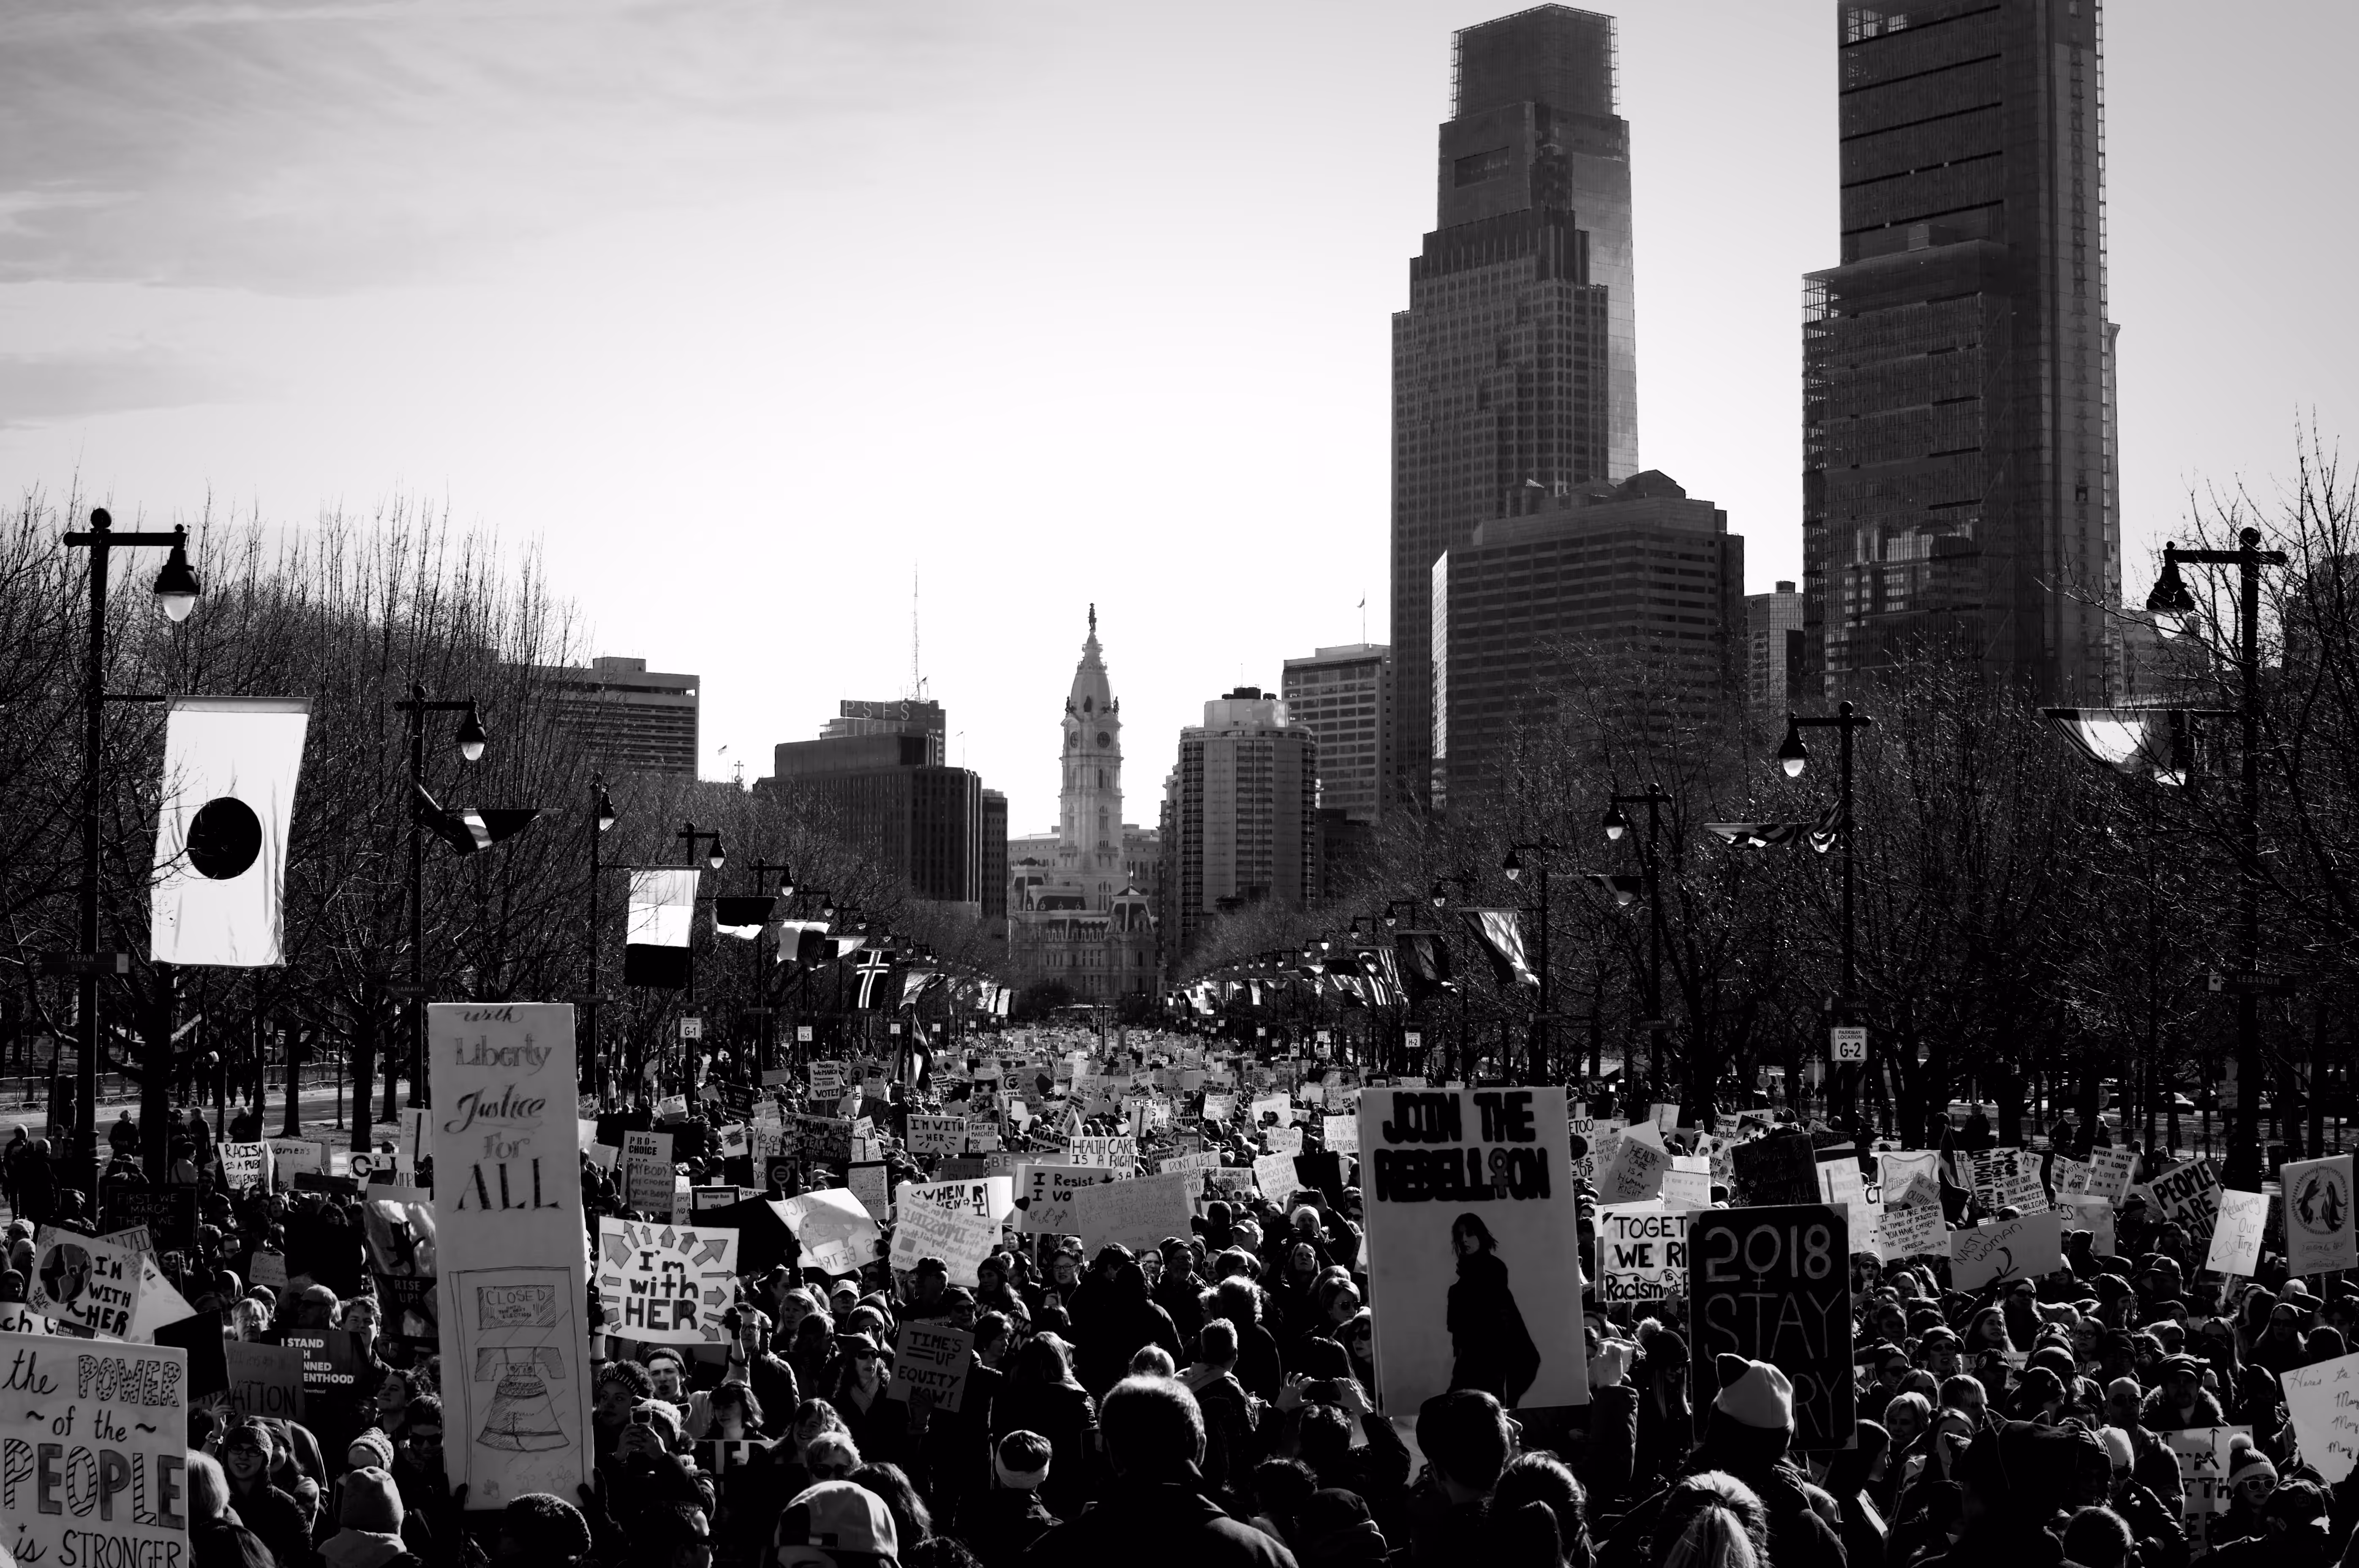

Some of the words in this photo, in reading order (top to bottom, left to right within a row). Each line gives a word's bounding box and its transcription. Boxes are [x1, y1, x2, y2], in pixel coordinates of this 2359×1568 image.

[66, 954, 94, 963] JAPAN
[2236, 975, 2280, 985] LEBANON
[464, 1006, 524, 1023] with
[685, 1026, 696, 1036] G-1
[455, 1033, 552, 1076] Liberty
[1840, 1042, 1861, 1057] G-2
[815, 1089, 839, 1097] VOTE!
[444, 1082, 546, 1134] Justice
[1382, 1092, 1462, 1144] JOIN
[1474, 1091, 1536, 1142] THE
[911, 1119, 930, 1130] I'M
[933, 1119, 964, 1132] WITH
[926, 1133, 945, 1142] HER
[1276, 1130, 1301, 1141] WOMAN'S
[629, 1145, 657, 1156] CHOICE
[1072, 1139, 1106, 1155] HEALTH
[1108, 1138, 1134, 1155] CARE
[1072, 1154, 1088, 1165] IS
[1098, 1154, 1104, 1166] A
[1109, 1154, 1135, 1169] RIGHT
[1196, 1153, 1213, 1167] LET
[2093, 1149, 2112, 1157] WHEN
[2116, 1154, 2133, 1162] HATE
[225, 1162, 235, 1170] IS
[238, 1161, 243, 1170] A
[644, 1165, 668, 1177] BODY
[1627, 1165, 1635, 1175] IS
[1629, 1157, 1647, 1171] CARE
[1972, 1150, 1993, 1187] HUMAN
[2065, 1162, 2081, 1174] VOTE
[2111, 1162, 2127, 1170] LOUD
[1033, 1173, 1046, 1186] I
[1054, 1173, 1094, 1187] Resist
[2099, 1171, 2116, 1179] LOVE
[454, 1157, 564, 1212] ALL
[1188, 1181, 1200, 1192] YOU
[2005, 1178, 2018, 1188] VOTE
[2152, 1160, 2216, 1211] PEOPLE
[923, 1184, 965, 1203] WHEN
[1032, 1189, 1043, 1201] I
[1617, 1184, 1643, 1198] RIGHT
[2007, 1187, 2017, 1196] THE
[117, 1193, 153, 1205] FIRST
[158, 1193, 179, 1203] WE
[131, 1204, 169, 1214] MARCH
[2177, 1191, 2218, 1223] ARE
[115, 1216, 150, 1225] THEN
[157, 1216, 176, 1225] WE
[1879, 1213, 1889, 1223] IF
[1907, 1209, 1919, 1217] ARE
[1613, 1216, 1687, 1239] TOGET
[1885, 1231, 1899, 1240] YOU
[1899, 1226, 1914, 1236] HAVE
[1915, 1219, 1935, 1230] CHOSEN
[2239, 1217, 2258, 1234] Our
[1954, 1227, 1989, 1265] NASTY
[2236, 1235, 2257, 1258] Time!
[1614, 1243, 1653, 1269] WE
[1704, 1224, 1832, 1284] 2018
[94, 1253, 122, 1280] I'M
[639, 1250, 685, 1274] I'm
[1664, 1272, 1673, 1281] is
[394, 1279, 422, 1290] RISE
[629, 1274, 699, 1299] with
[1605, 1274, 1663, 1301] Racism
[34, 1287, 52, 1310] SAVE
[88, 1282, 132, 1308] WITH
[398, 1293, 419, 1305] UP!
[487, 1289, 545, 1305] CLOSED
[85, 1305, 129, 1336] HER
[625, 1296, 698, 1331] HER
[1704, 1288, 1844, 1363] STAY
[281, 1337, 285, 1347] I
[287, 1337, 325, 1348] STAND
[910, 1331, 964, 1353] TIME'S
[936, 1353, 956, 1367] UP
[3, 1349, 59, 1395] the
[79, 1355, 182, 1407] POWER
[303, 1372, 355, 1385] ENTHOOD
[898, 1366, 961, 1389] EQUITY
[94, 1409, 127, 1442] the
[4, 1438, 185, 1530] PEOPLE
[14, 1522, 48, 1562] is
[59, 1530, 181, 1568] STRONGER
